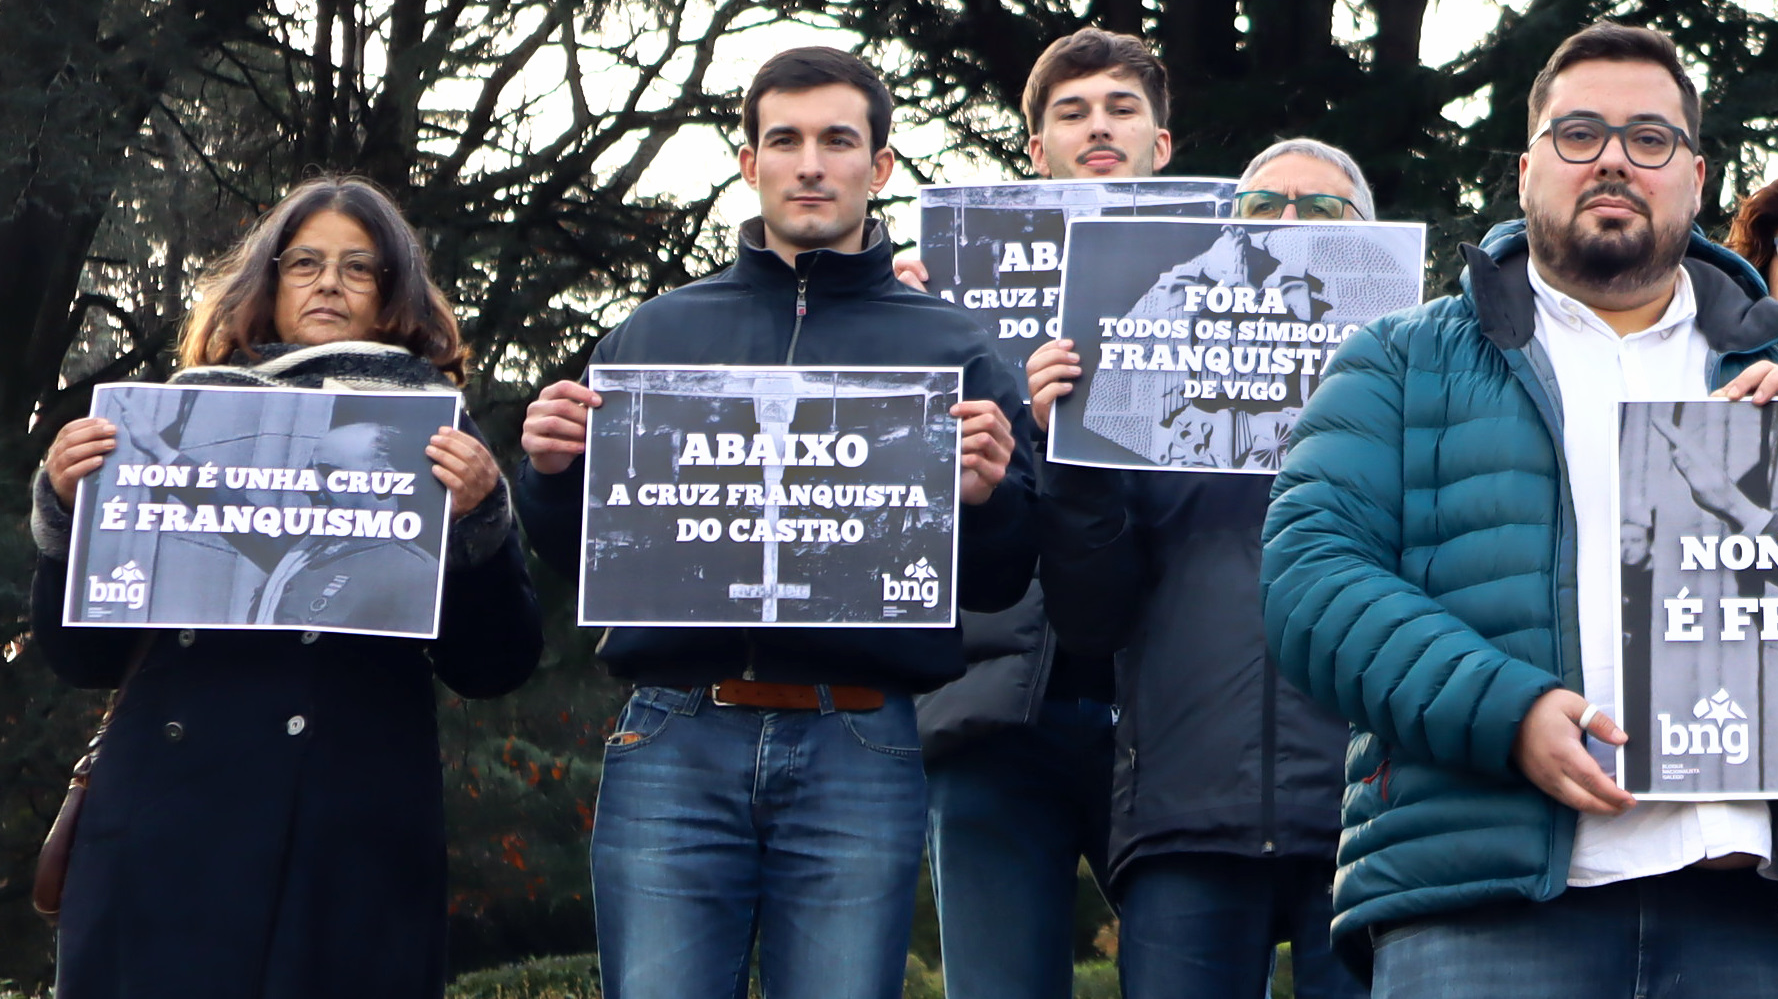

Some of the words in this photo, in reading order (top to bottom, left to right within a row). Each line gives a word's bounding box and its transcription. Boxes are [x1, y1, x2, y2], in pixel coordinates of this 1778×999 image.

[963, 287, 1037, 309] CRUZ
[1182, 281, 1287, 315] FÓRA
[998, 318, 1039, 339] DO
[1099, 318, 1191, 339] TODOS
[1195, 319, 1233, 341] OS
[1098, 343, 1337, 377] FRANQUIST
[1184, 380, 1222, 400] DE
[1225, 381, 1287, 401] VIGO
[678, 433, 869, 468] ABAIXO
[116, 464, 191, 488] NON
[196, 460, 223, 489] É
[224, 466, 320, 492] UNHA
[326, 469, 416, 496] CRUZ
[607, 484, 631, 506] A
[637, 484, 720, 506] CRUZ
[726, 484, 929, 509] FRANQUISTA
[100, 496, 128, 531] É
[135, 502, 422, 540] FRANQUISMO
[676, 518, 722, 543] DO
[728, 518, 865, 543] CASTRO
[88, 575, 146, 610] bng
[881, 573, 939, 608] bng
[1664, 587, 1705, 642] É
[1657, 713, 1749, 765] bng
